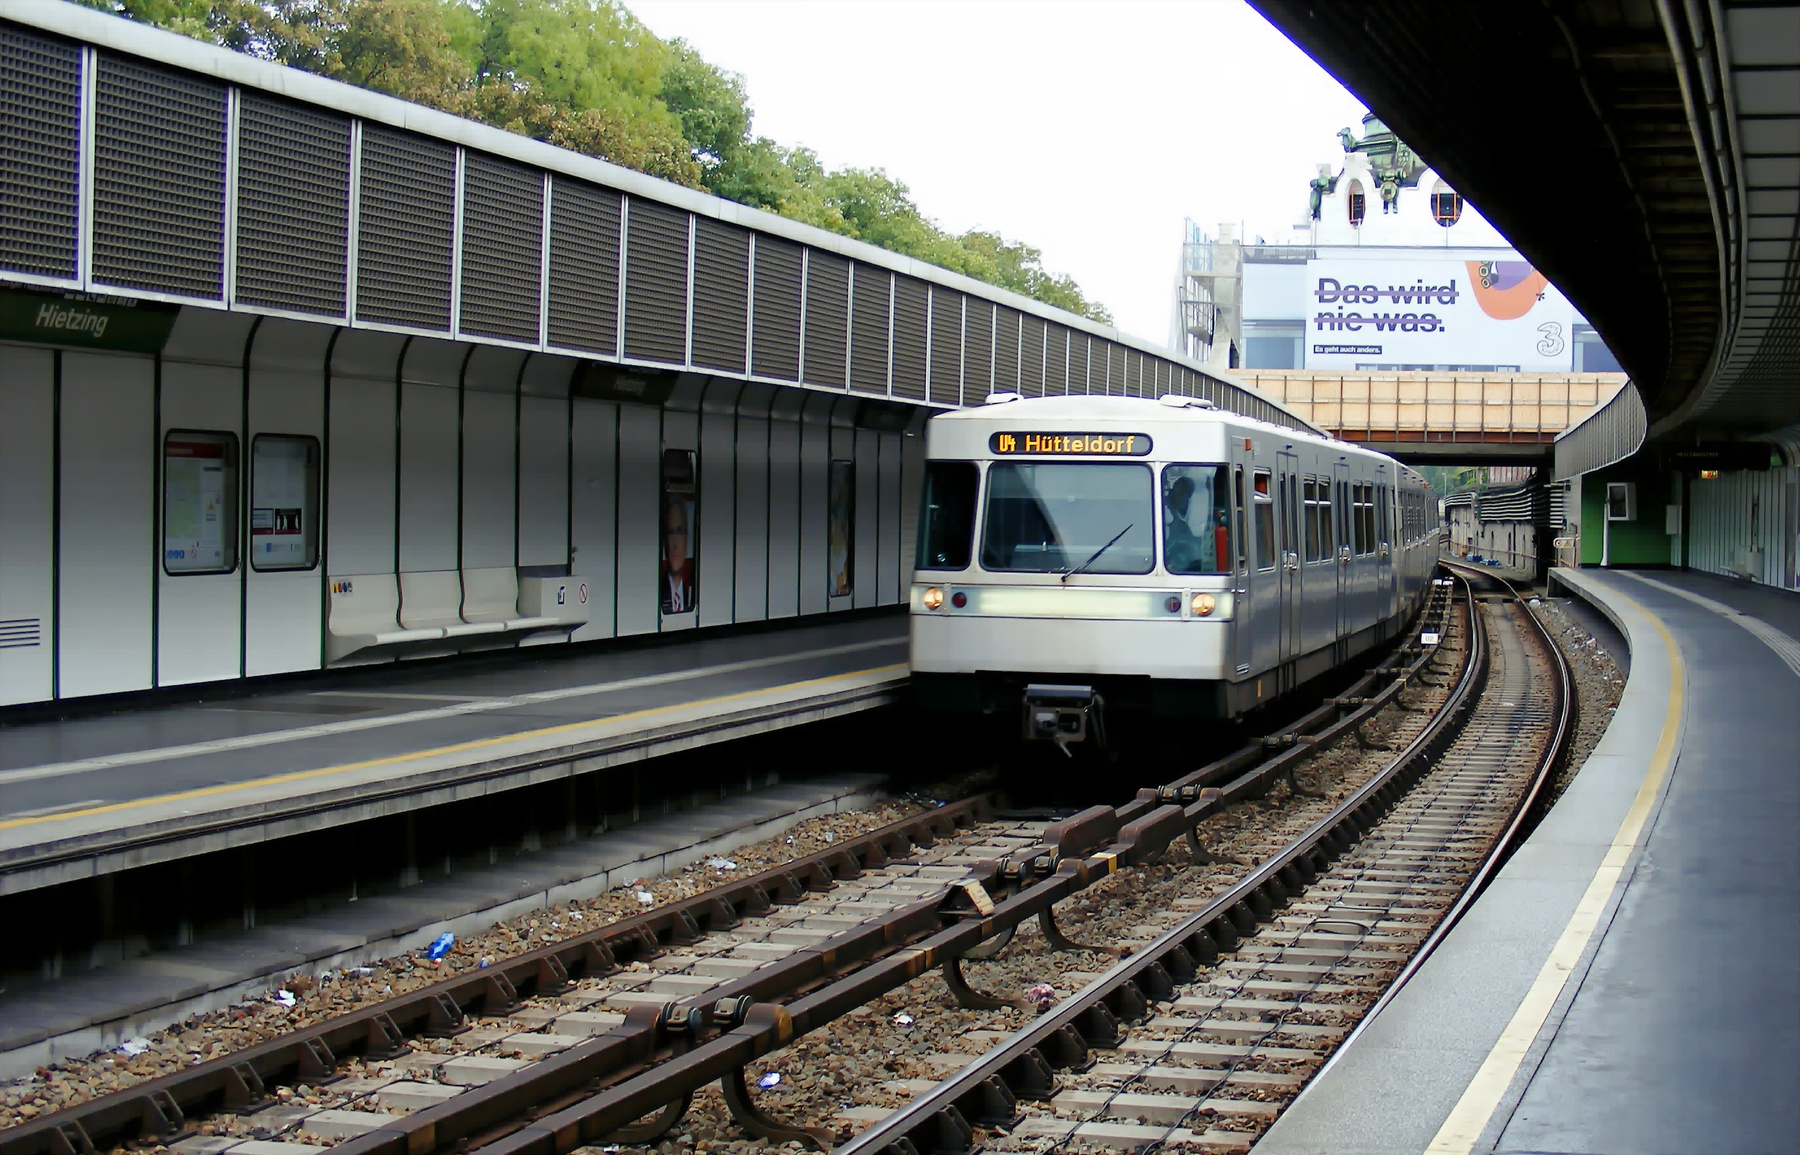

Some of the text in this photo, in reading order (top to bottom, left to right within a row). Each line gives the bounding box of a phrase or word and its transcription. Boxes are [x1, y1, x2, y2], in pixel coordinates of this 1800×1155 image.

[1318, 278, 1457, 305] Das wird
[36, 303, 109, 338] Hietzing
[1317, 306, 1446, 333] nie was.
[1025, 434, 1136, 454] Hütteldorf
